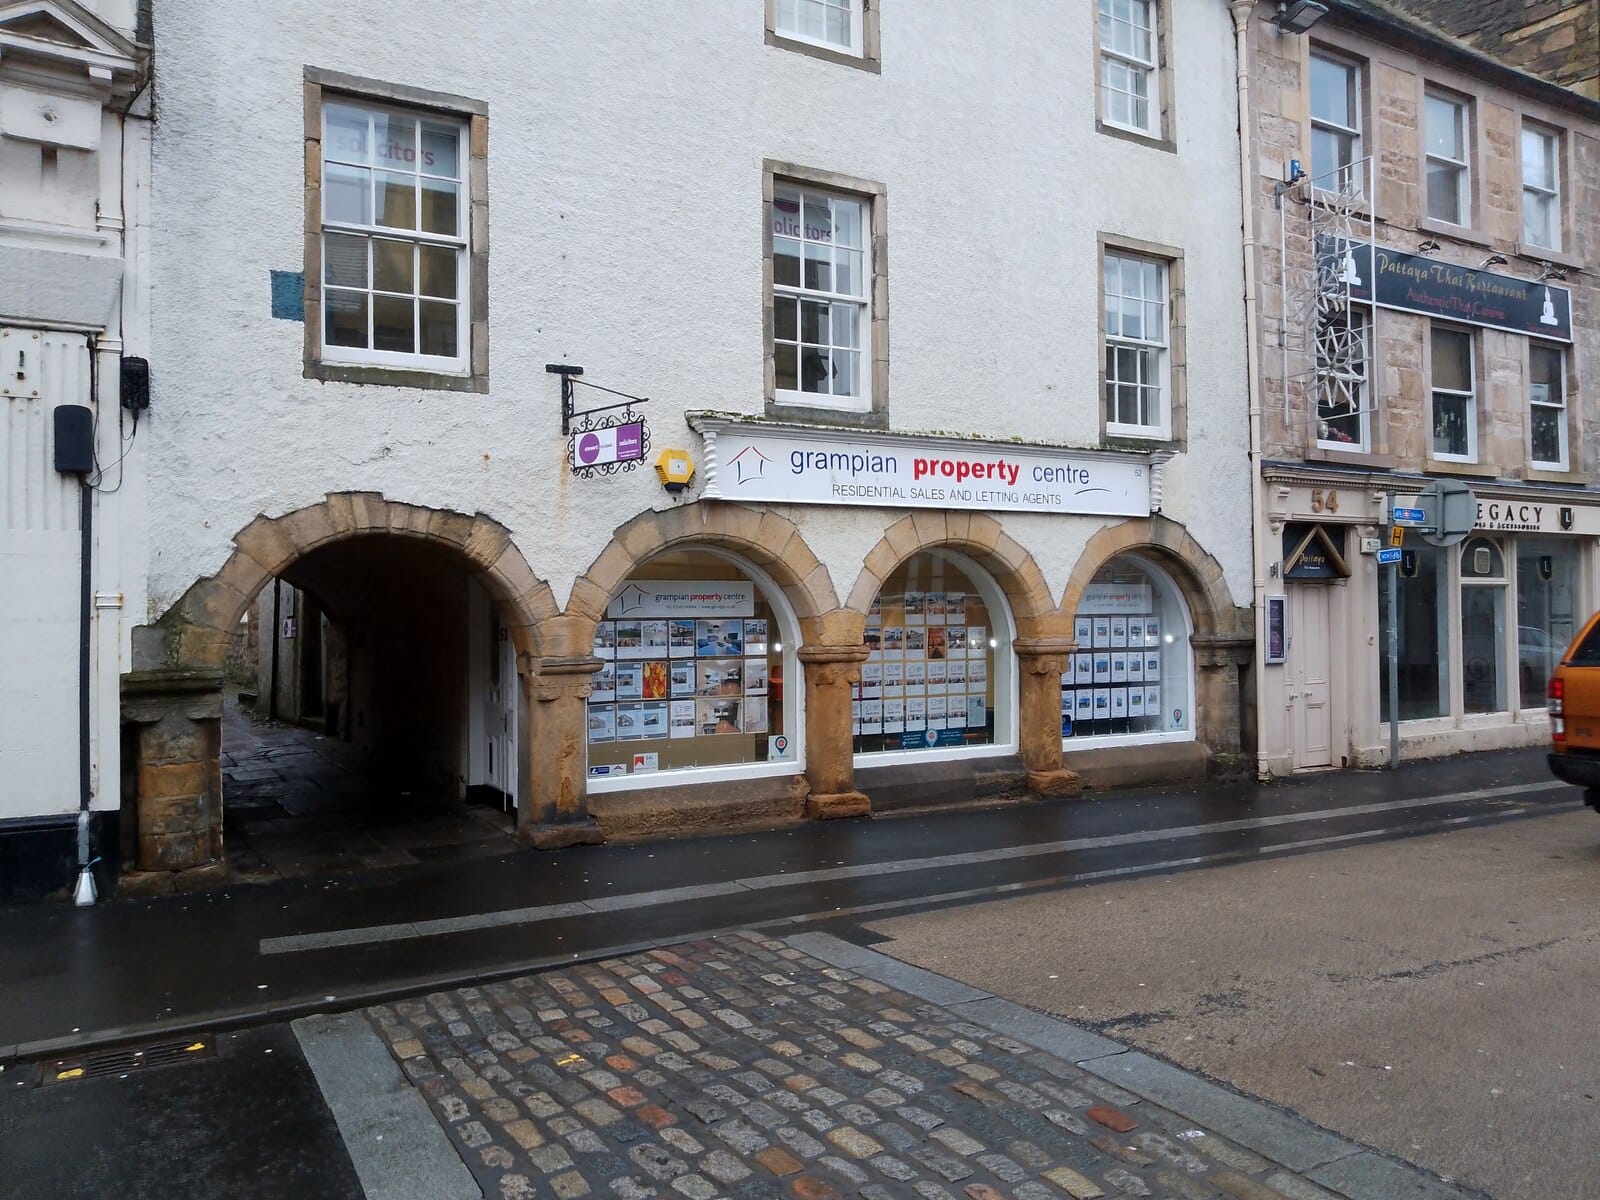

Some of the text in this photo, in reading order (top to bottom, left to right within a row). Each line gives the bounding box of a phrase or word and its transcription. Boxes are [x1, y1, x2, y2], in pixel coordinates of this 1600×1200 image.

[337, 133, 435, 166] solcitos
[773, 217, 832, 241] olictors
[1376, 252, 1527, 300] Pattaya Thai Restaurant
[790, 449, 1090, 486] grampian property centre
[832, 483, 1062, 505] RESIDENTIAL SALES AND LETTING AGENTS
[1311, 490, 1339, 514] 54
[1476, 503, 1542, 523] EGACY
[1392, 528, 1402, 546] H
[655, 592, 746, 602] grampian property centre
